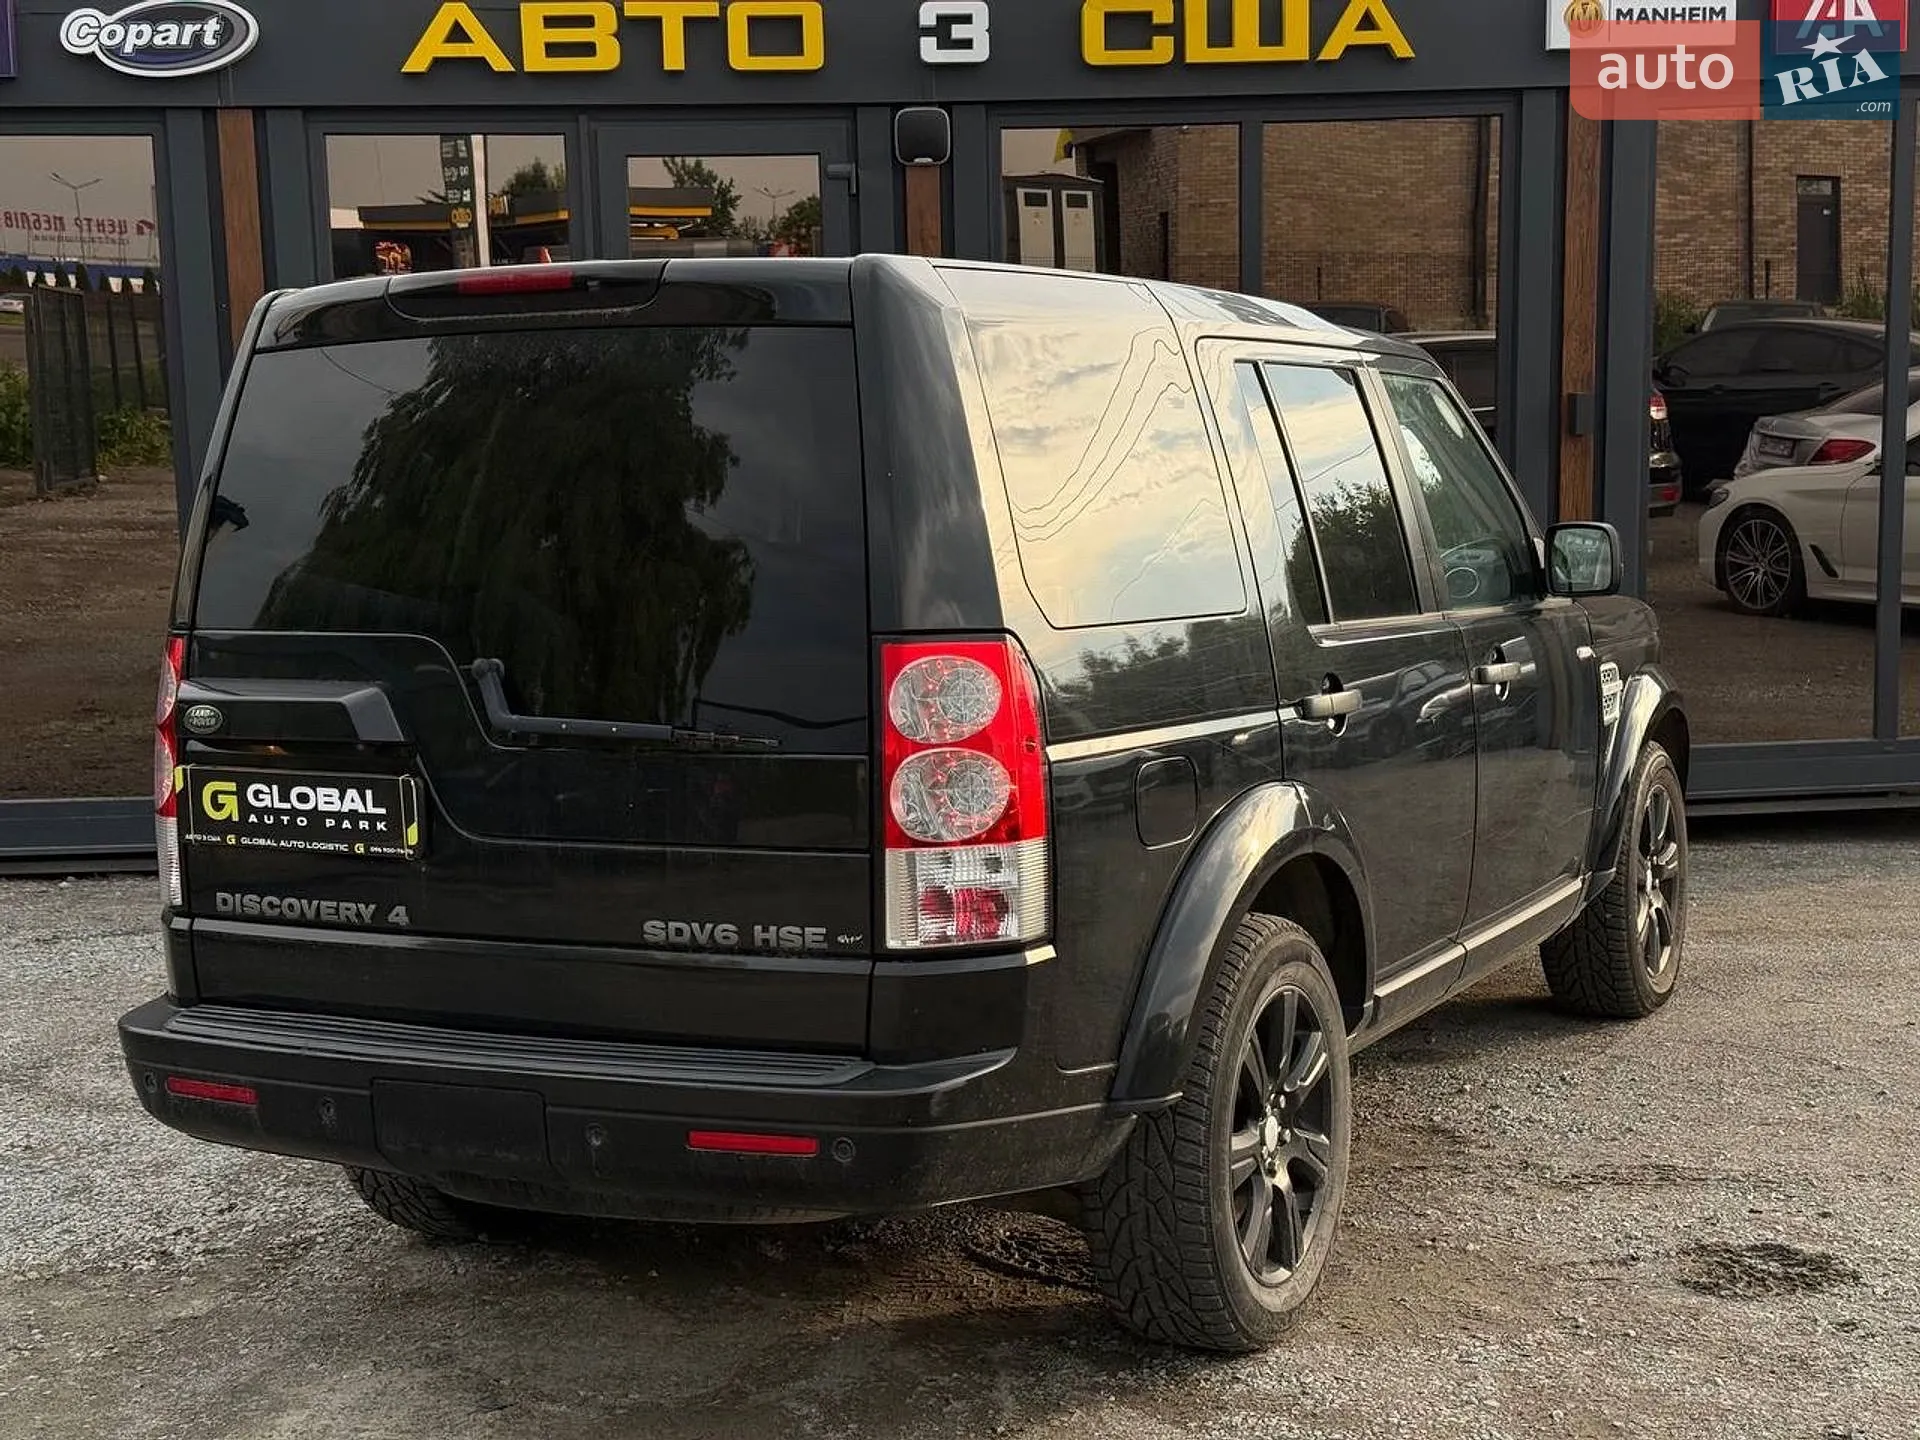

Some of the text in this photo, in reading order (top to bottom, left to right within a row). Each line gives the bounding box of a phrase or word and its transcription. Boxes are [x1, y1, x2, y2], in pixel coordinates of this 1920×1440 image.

[1615, 6, 1727, 25] MANHEIM
[67, 14, 222, 55] Copart
[401, 0, 1416, 72] АВТО З США
[246, 783, 387, 815] GLOBAL
[247, 812, 388, 832] AUTO PARK
[240, 836, 349, 852] GLOBAL AUTO LOGISTIC
[215, 892, 410, 926] DISCOVERY 4
[642, 919, 739, 946] SDV6
[753, 924, 829, 950] HSE
